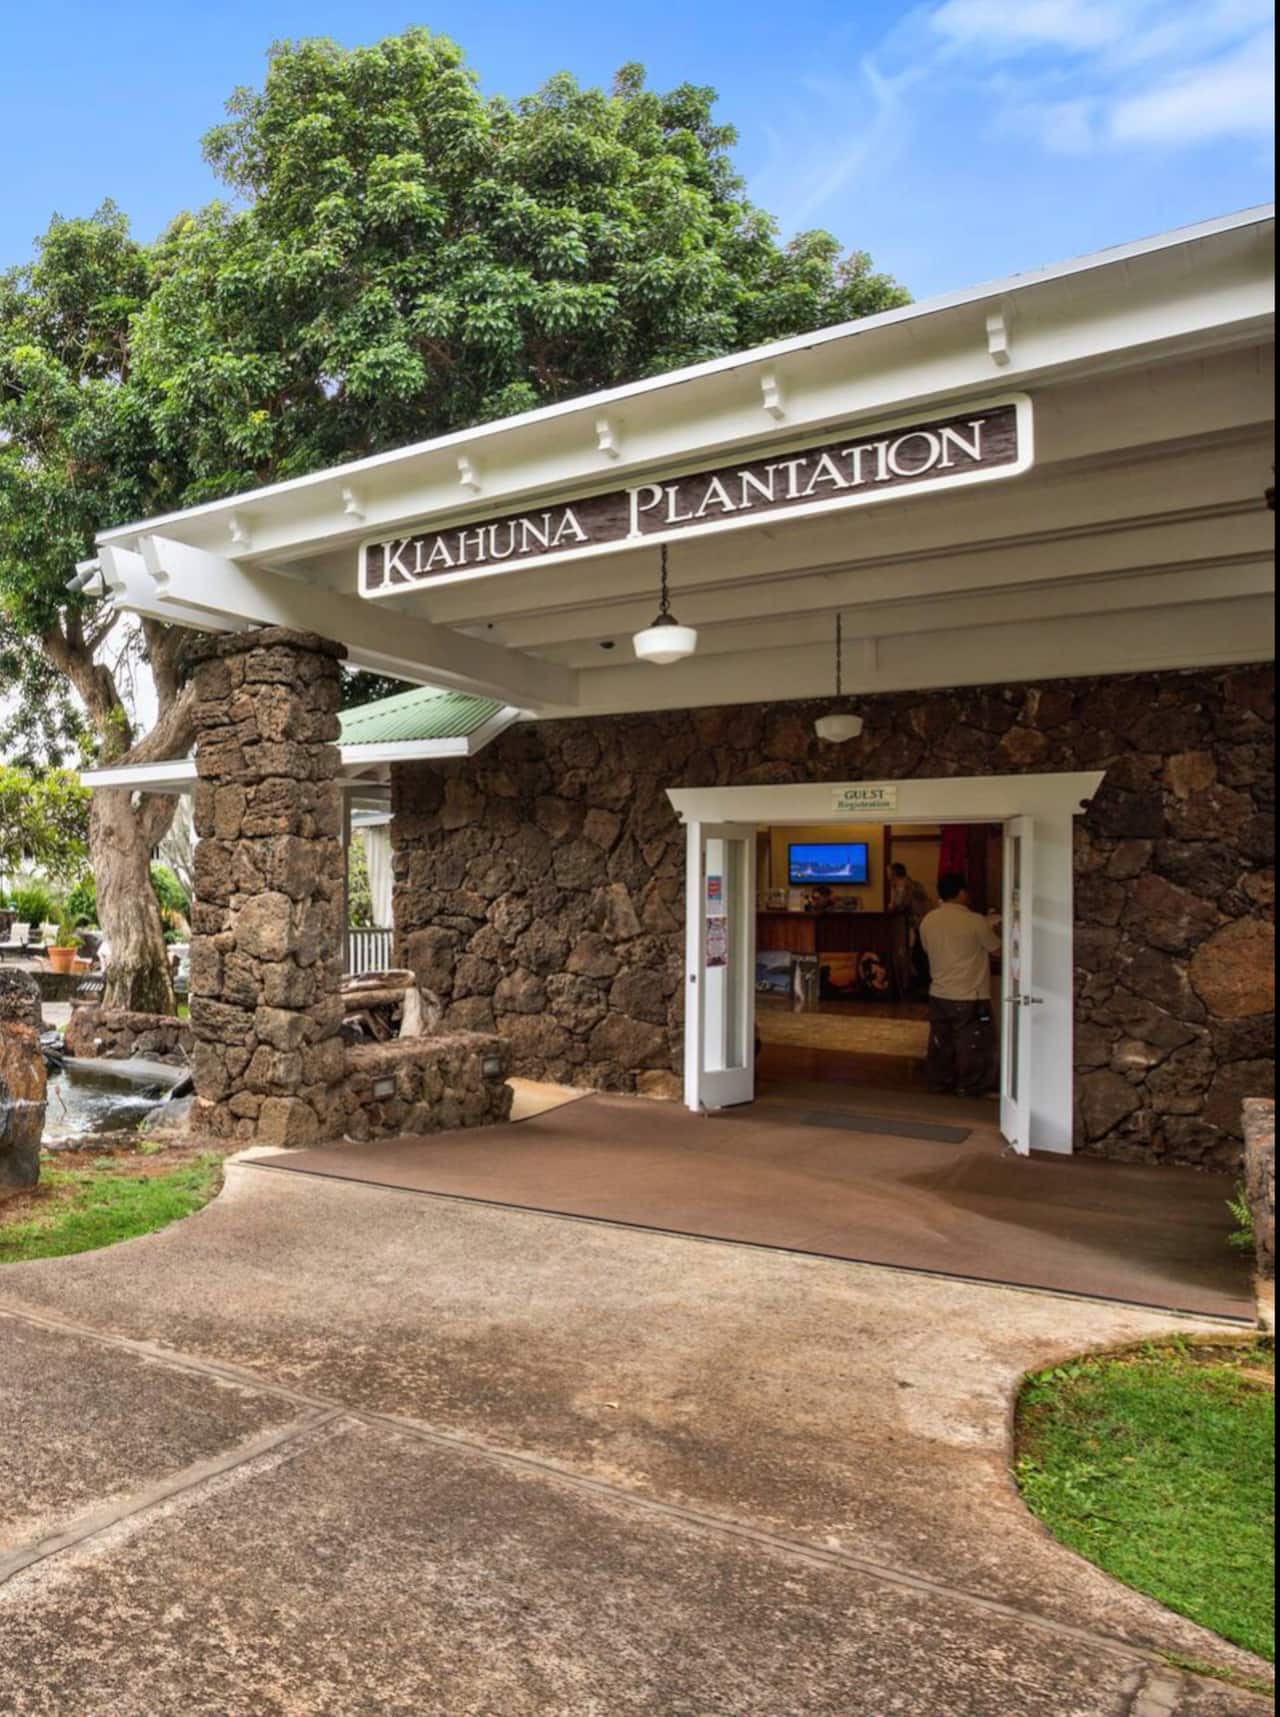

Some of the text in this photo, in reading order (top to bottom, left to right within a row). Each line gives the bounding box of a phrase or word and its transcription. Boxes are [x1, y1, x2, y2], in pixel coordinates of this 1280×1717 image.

[379, 419, 986, 588] KIAHUNA PLANTATION
[843, 789, 885, 800] GUEST
